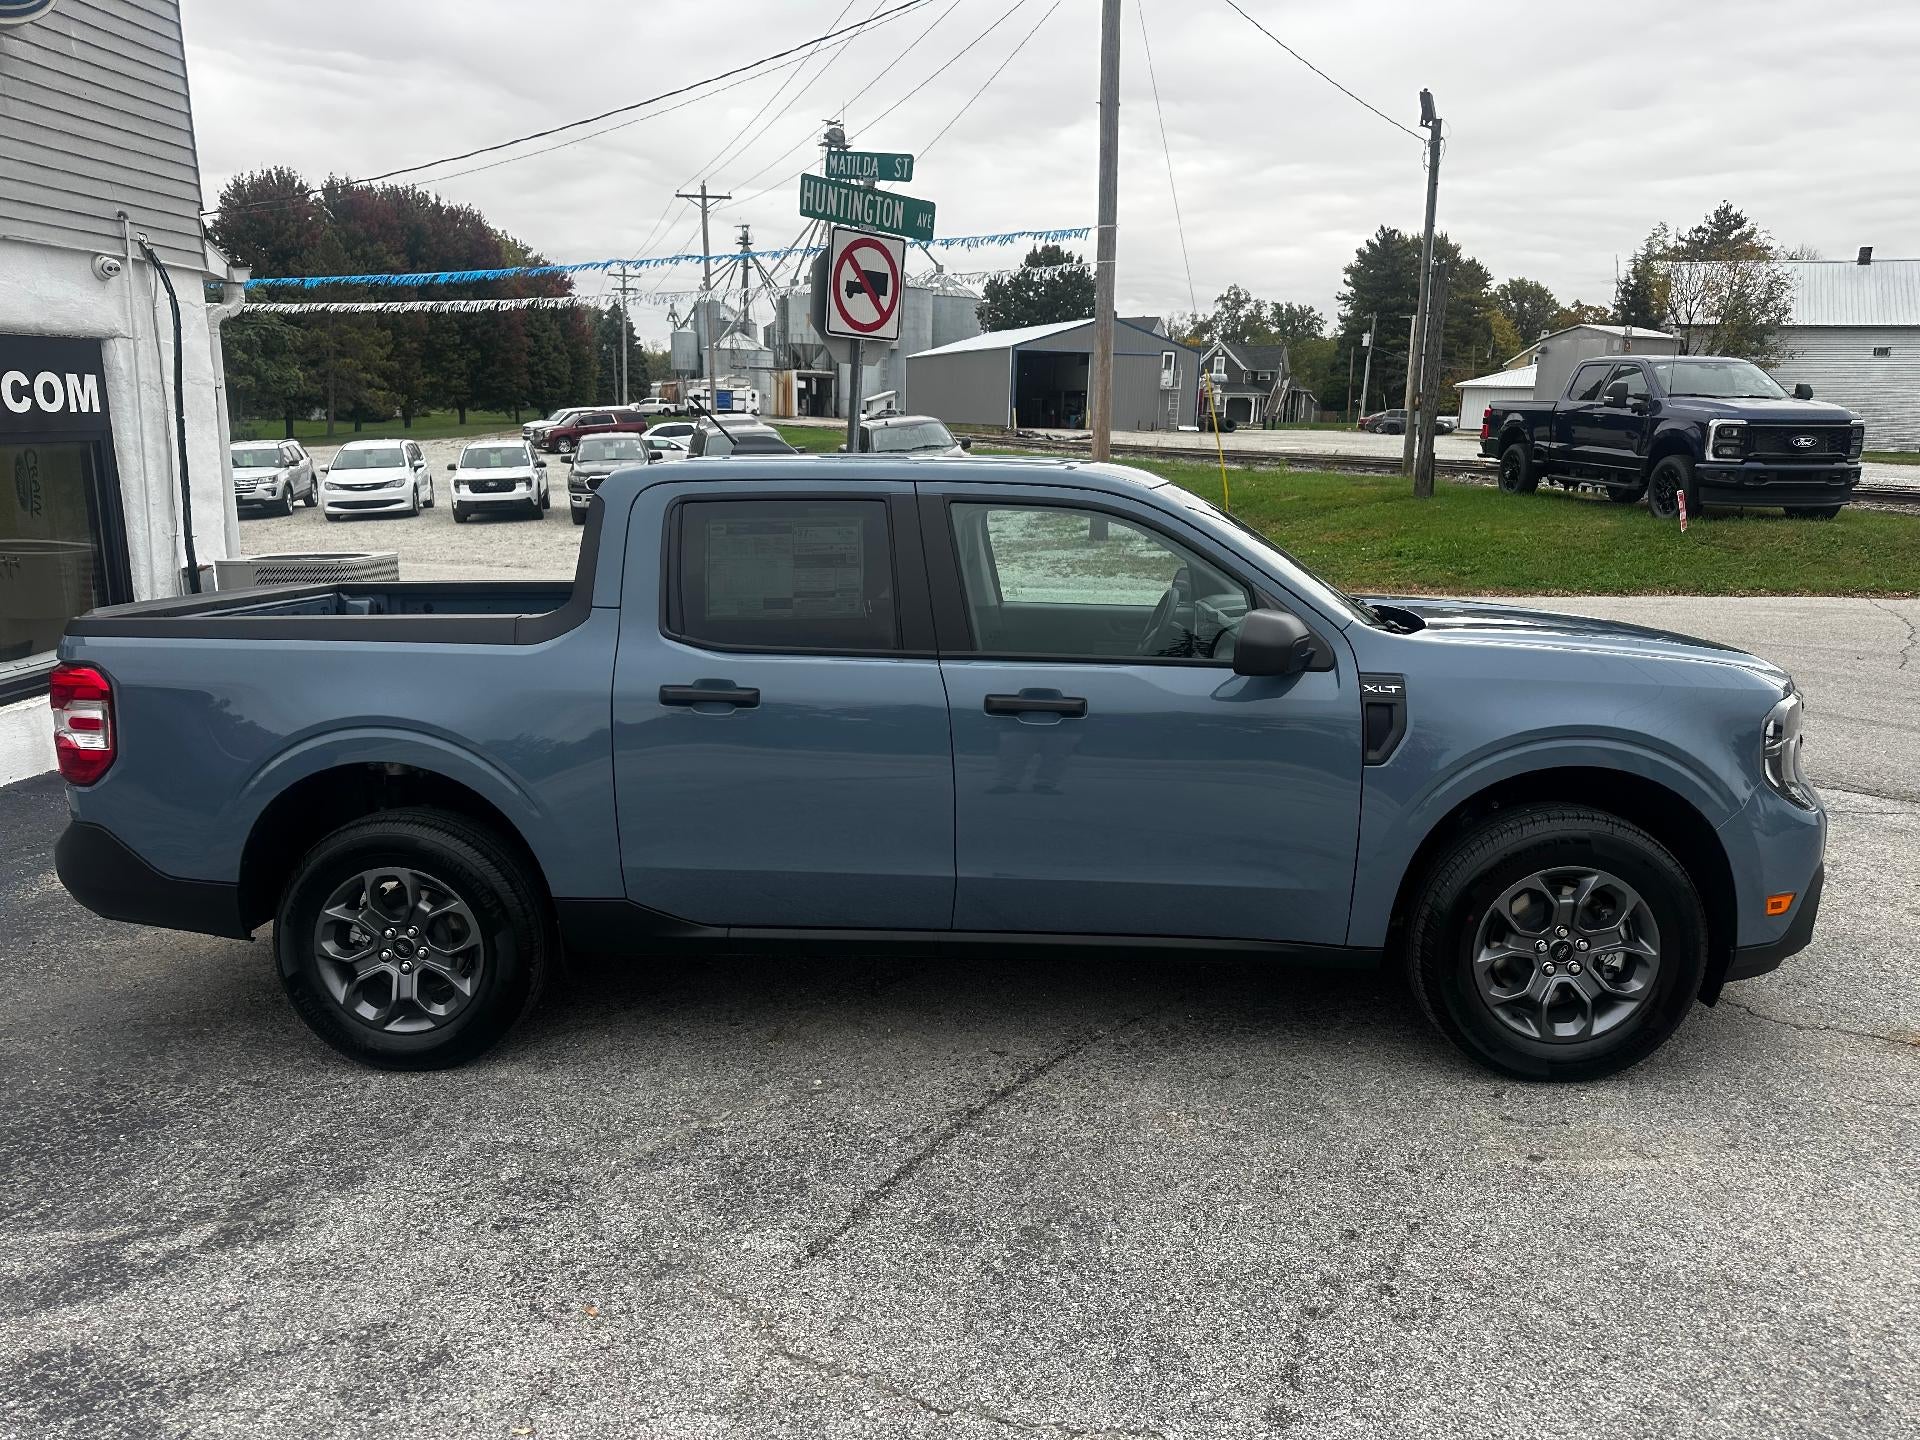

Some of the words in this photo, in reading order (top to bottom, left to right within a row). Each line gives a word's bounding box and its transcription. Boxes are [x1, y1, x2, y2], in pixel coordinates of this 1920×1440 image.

[829, 154, 879, 177] MATILDA
[894, 157, 911, 178] ST
[802, 179, 905, 230] HUNTINGTON
[916, 212, 932, 229] AVE
[0, 370, 101, 413] COM
[1363, 684, 1402, 694] XLT
